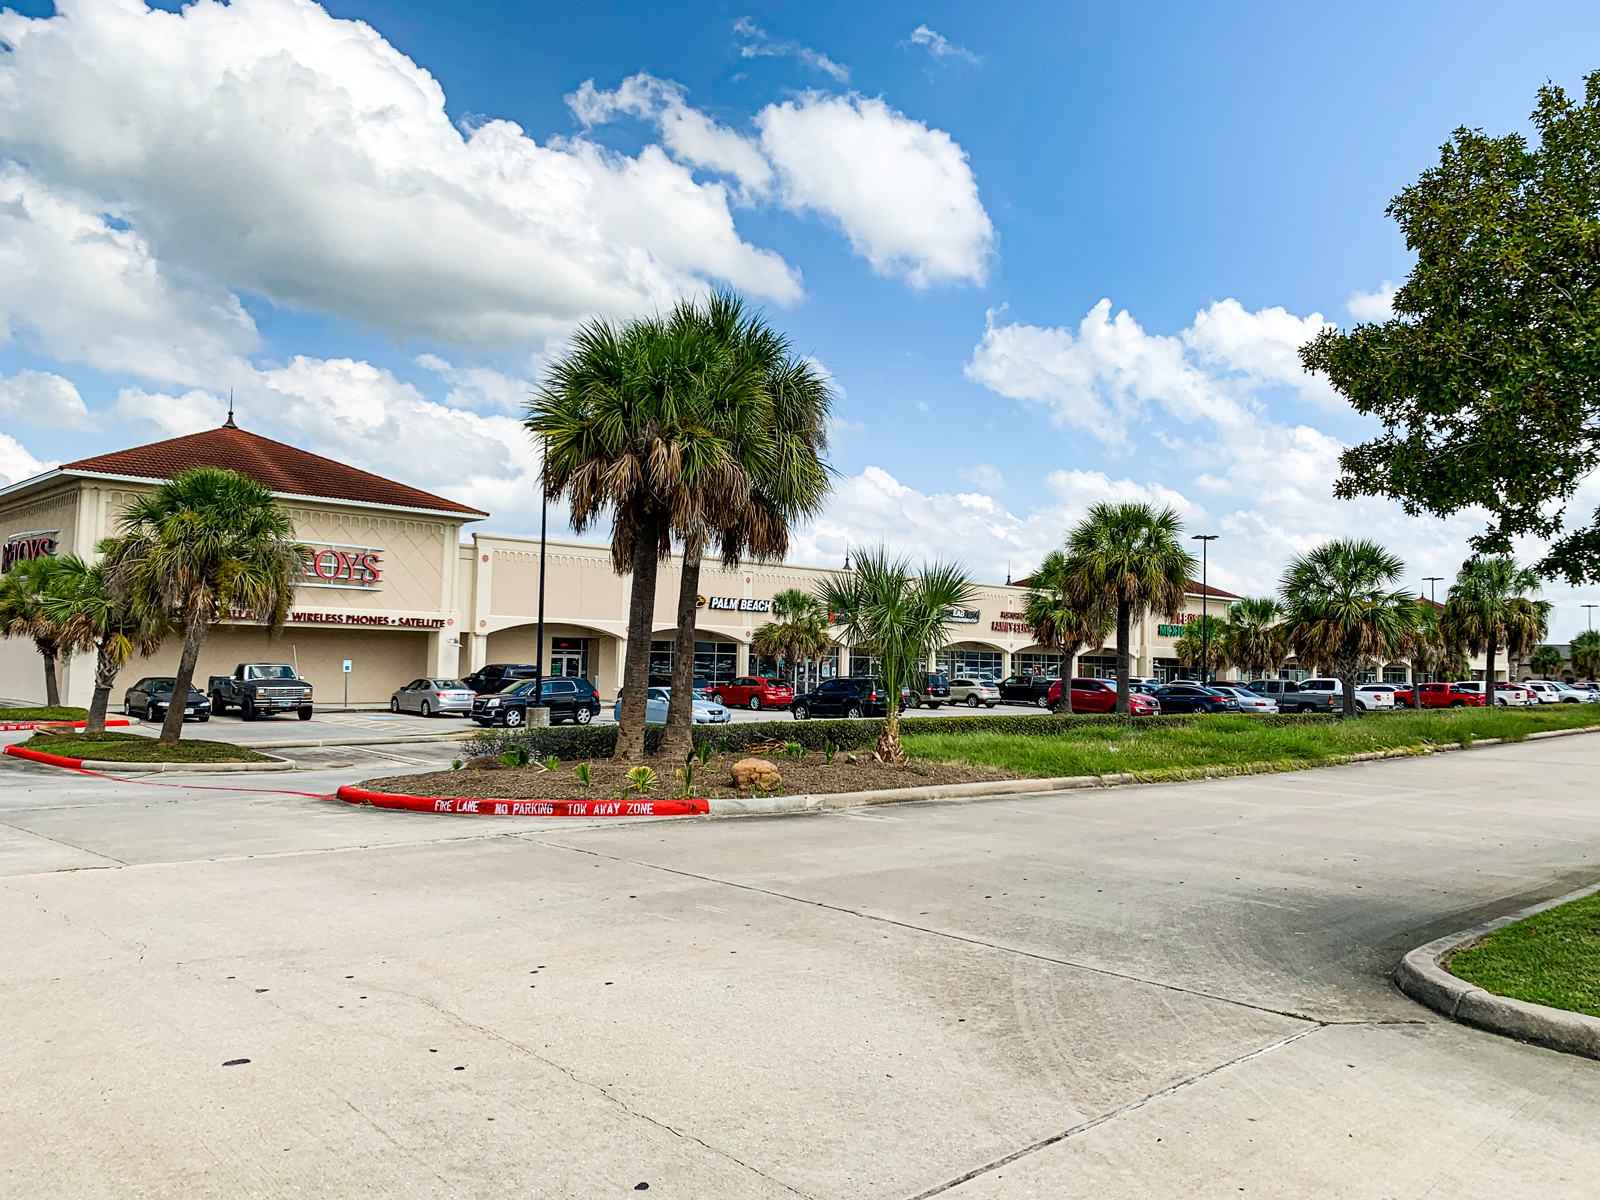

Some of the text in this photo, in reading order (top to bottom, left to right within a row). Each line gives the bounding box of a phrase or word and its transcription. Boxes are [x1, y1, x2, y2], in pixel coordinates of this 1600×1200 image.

[711, 597, 738, 610] PALM
[740, 599, 772, 612] BEACH
[292, 612, 445, 628] WIRELESS PHONES SATELLITE
[434, 800, 654, 815] FIRE LANE NO PARKING TOW AWAY ZONE
